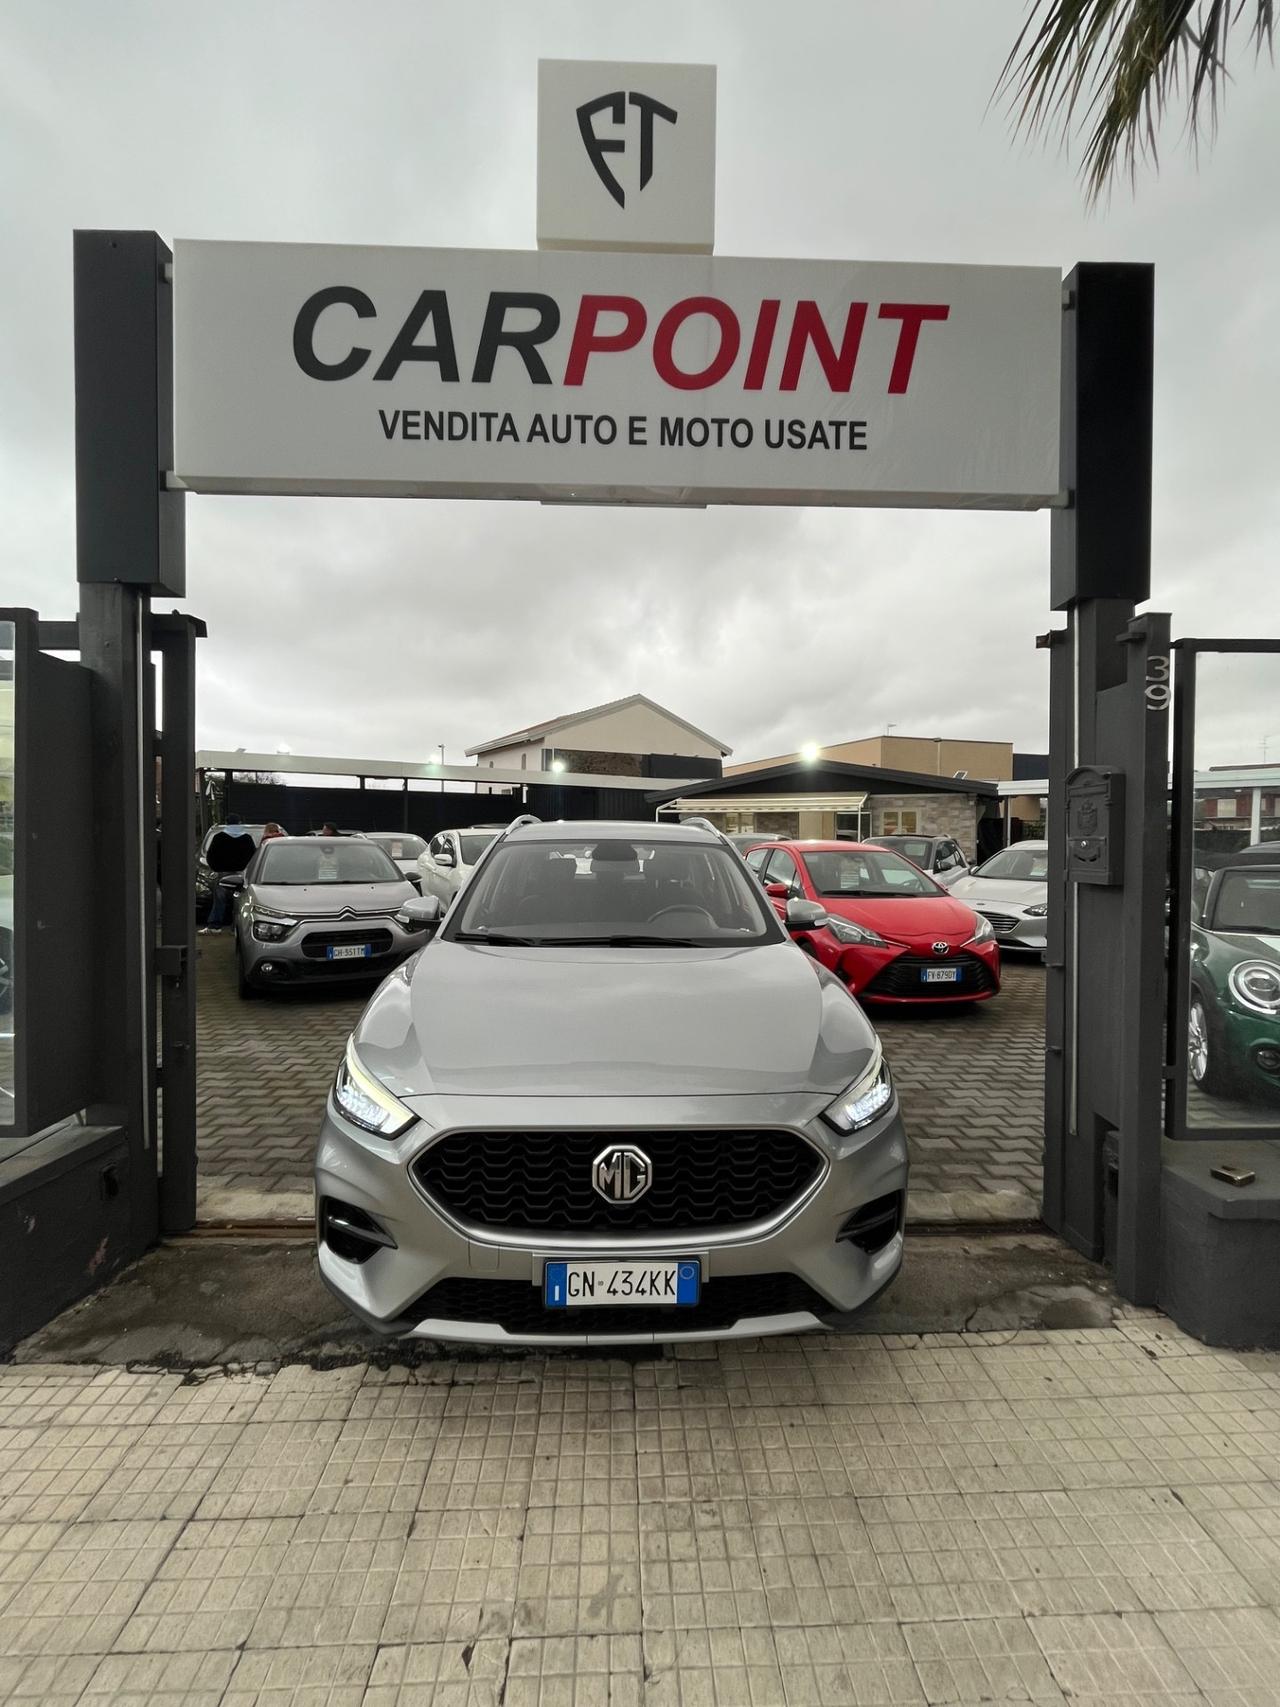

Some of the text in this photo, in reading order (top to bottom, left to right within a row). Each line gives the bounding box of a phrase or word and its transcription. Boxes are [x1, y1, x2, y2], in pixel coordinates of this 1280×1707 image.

[379, 409, 868, 451] VENDITA AUTO E MOTO USATE
[1145, 655, 1172, 711] 39
[599, 1152, 646, 1199] MG
